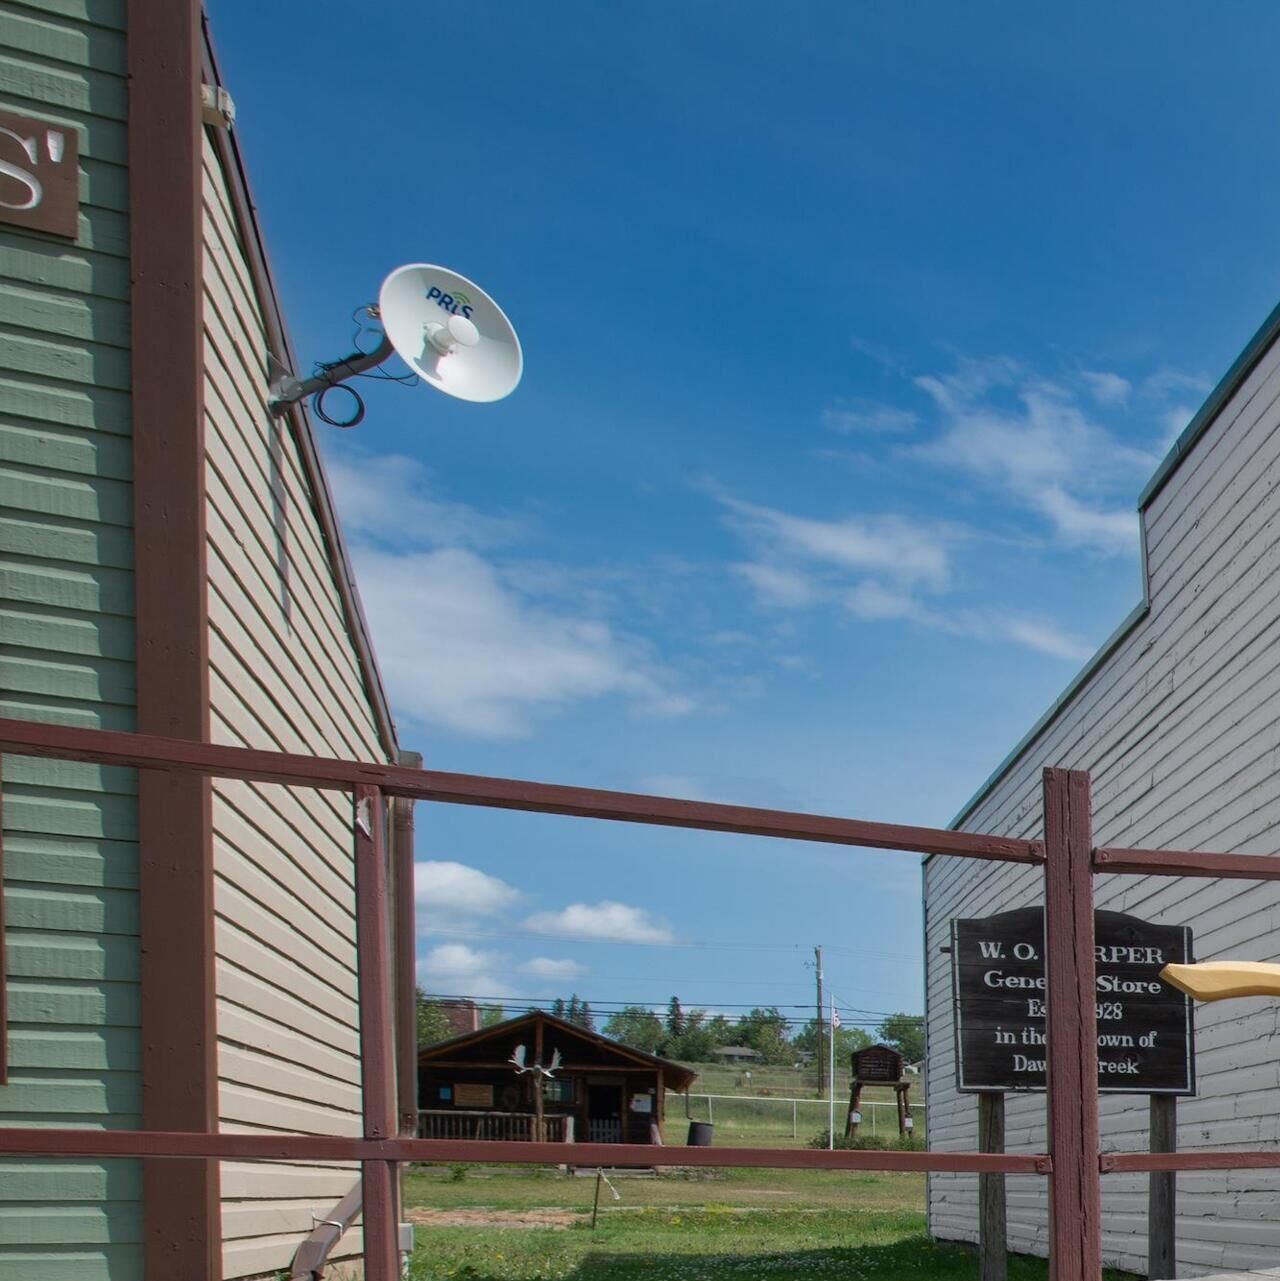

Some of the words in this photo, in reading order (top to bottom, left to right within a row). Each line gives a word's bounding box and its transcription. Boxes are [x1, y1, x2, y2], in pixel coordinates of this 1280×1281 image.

[978, 941, 1006, 959] W.
[1013, 943, 1039, 960] O.
[1094, 945, 1165, 964] RPER
[984, 970, 1047, 989] Gene
[1096, 975, 1161, 994] Store
[995, 1026, 1017, 1044] in
[1097, 1034, 1134, 1047] own
[1138, 1031, 1157, 1047] of
[1097, 1057, 1140, 1074] reek
